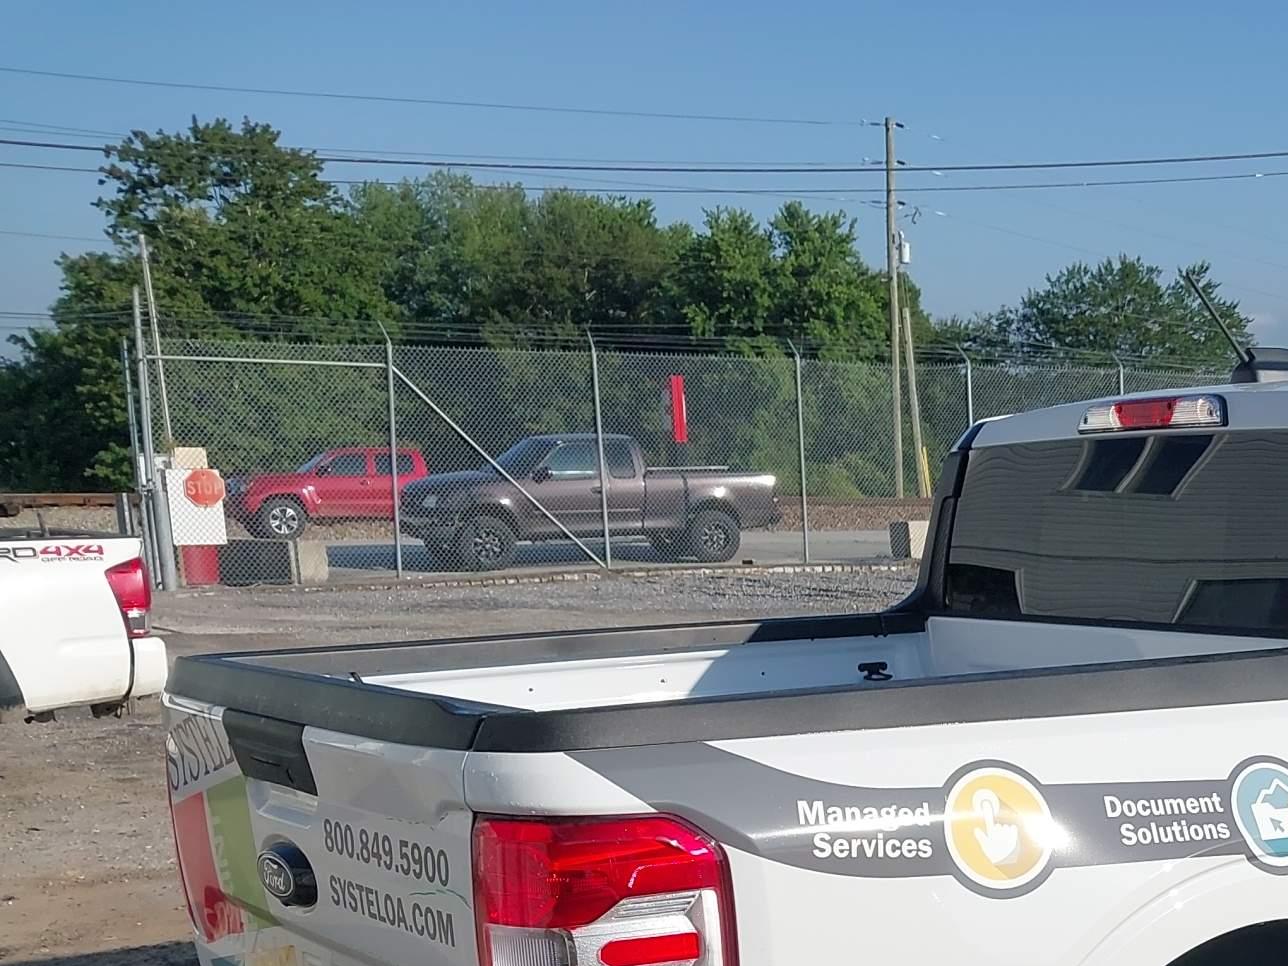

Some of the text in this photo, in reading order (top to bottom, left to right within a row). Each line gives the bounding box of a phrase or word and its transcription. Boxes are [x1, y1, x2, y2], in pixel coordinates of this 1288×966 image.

[187, 480, 219, 496] STOP
[167, 713, 236, 791] SYSTEL
[796, 799, 932, 831] Managed
[1103, 792, 1225, 818] Document
[811, 832, 933, 859] Services
[1119, 819, 1231, 846] Solutions
[323, 818, 450, 887] 800.849.5900
[329, 875, 456, 948] SYSTELOA.COM
